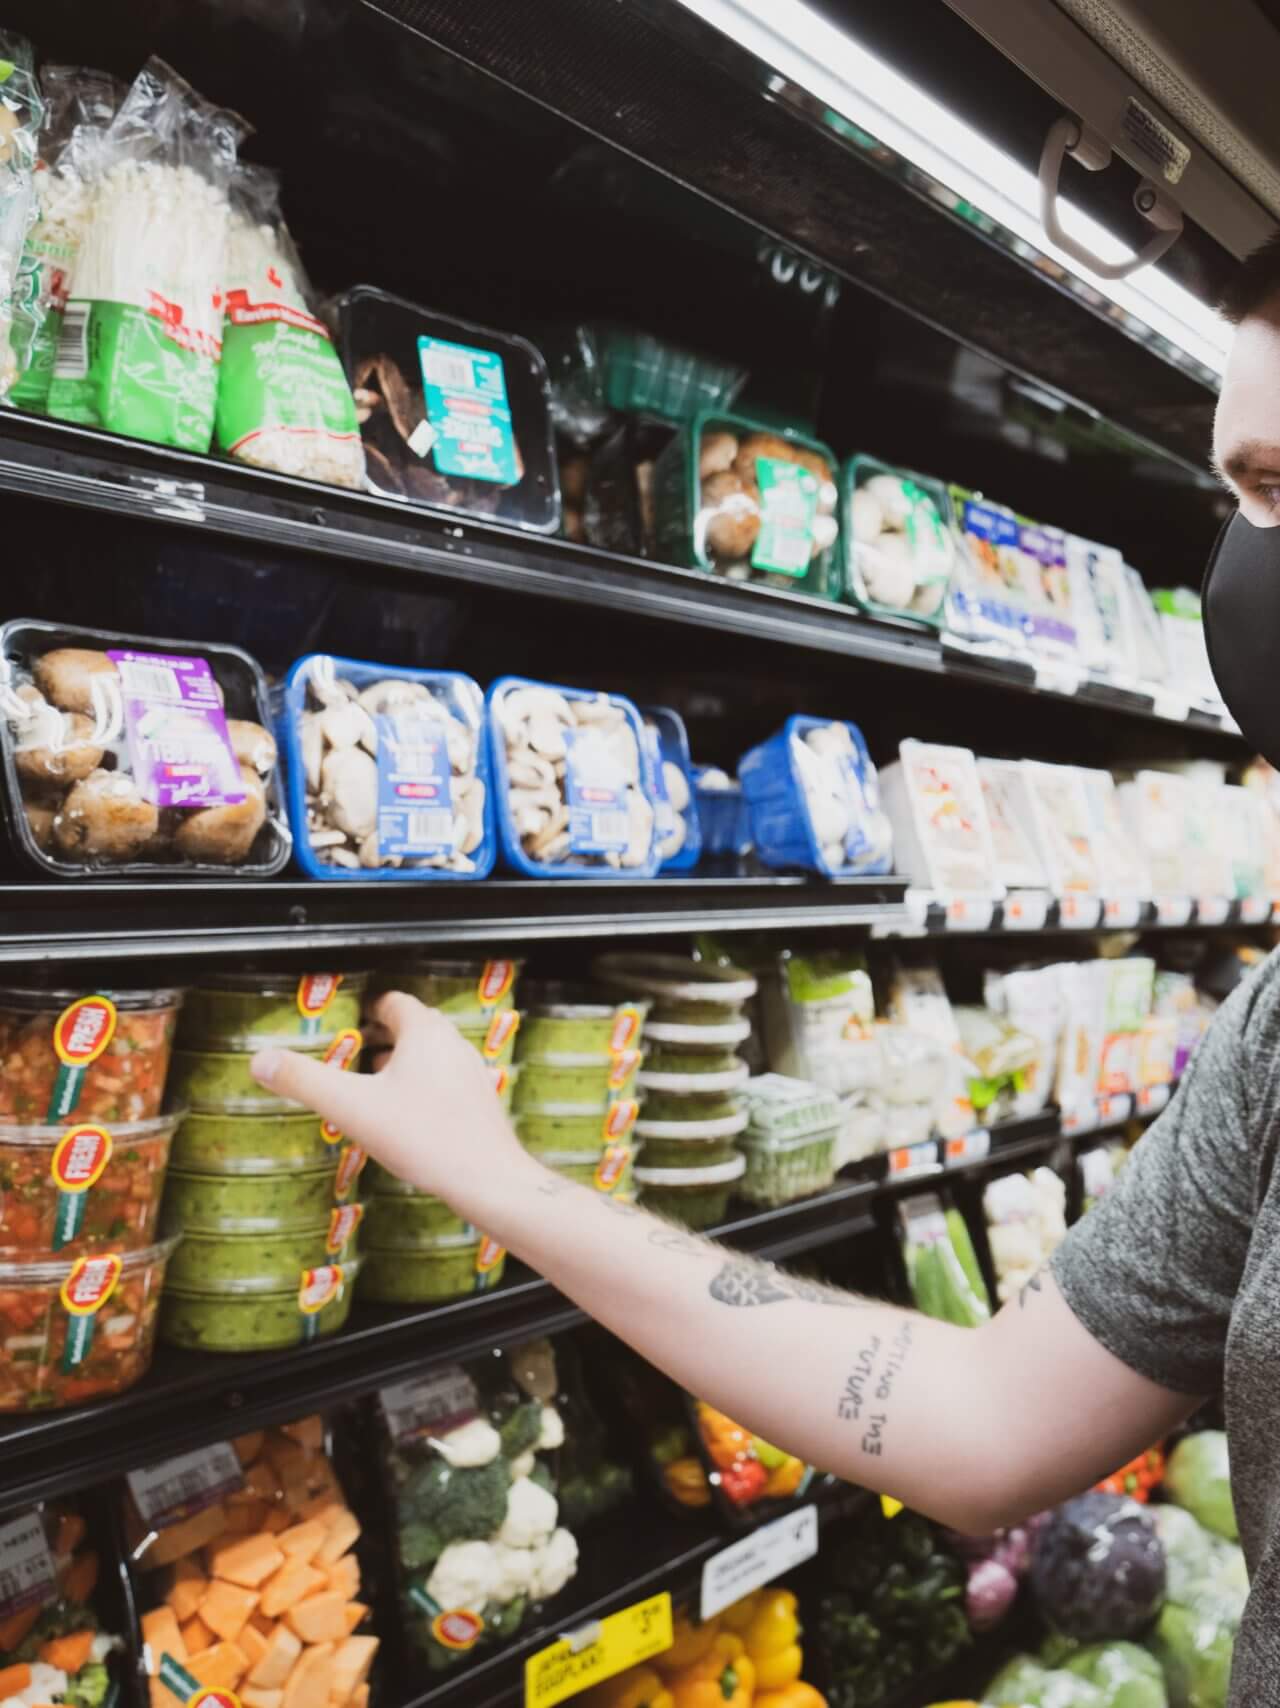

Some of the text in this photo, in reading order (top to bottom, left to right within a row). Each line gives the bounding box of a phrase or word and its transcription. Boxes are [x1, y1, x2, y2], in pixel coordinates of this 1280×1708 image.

[67, 1007, 106, 1052] FRESH
[64, 1135, 101, 1179] FRESH
[74, 1260, 112, 1302] FRESH
[838, 1335, 881, 1420] FUTURE
[861, 1413, 887, 1456] THE
